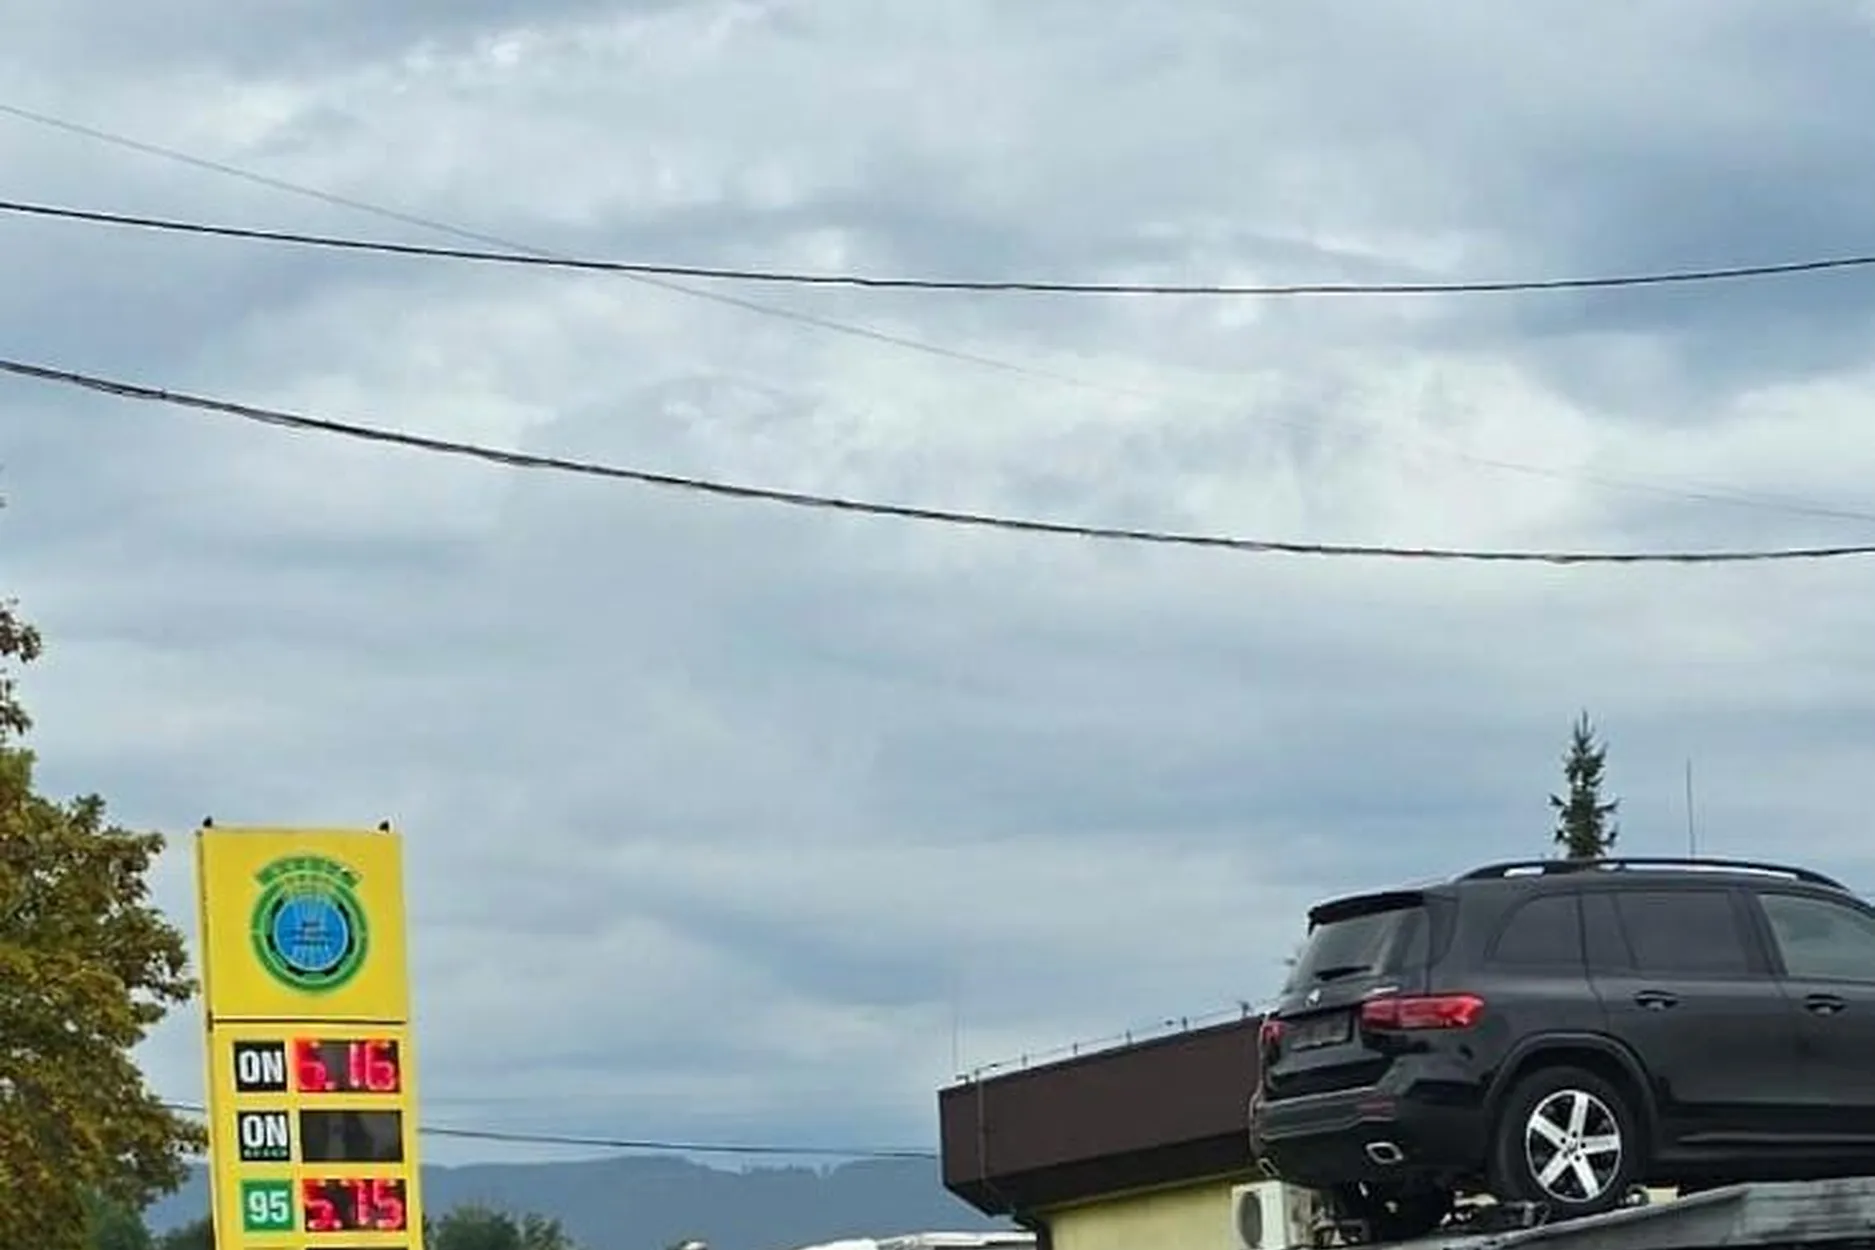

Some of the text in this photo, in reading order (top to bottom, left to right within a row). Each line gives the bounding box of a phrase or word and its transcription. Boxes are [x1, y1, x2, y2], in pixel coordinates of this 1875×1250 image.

[238, 1050, 285, 1084] ON
[242, 1114, 288, 1148] ON
[249, 1190, 289, 1224] 95
